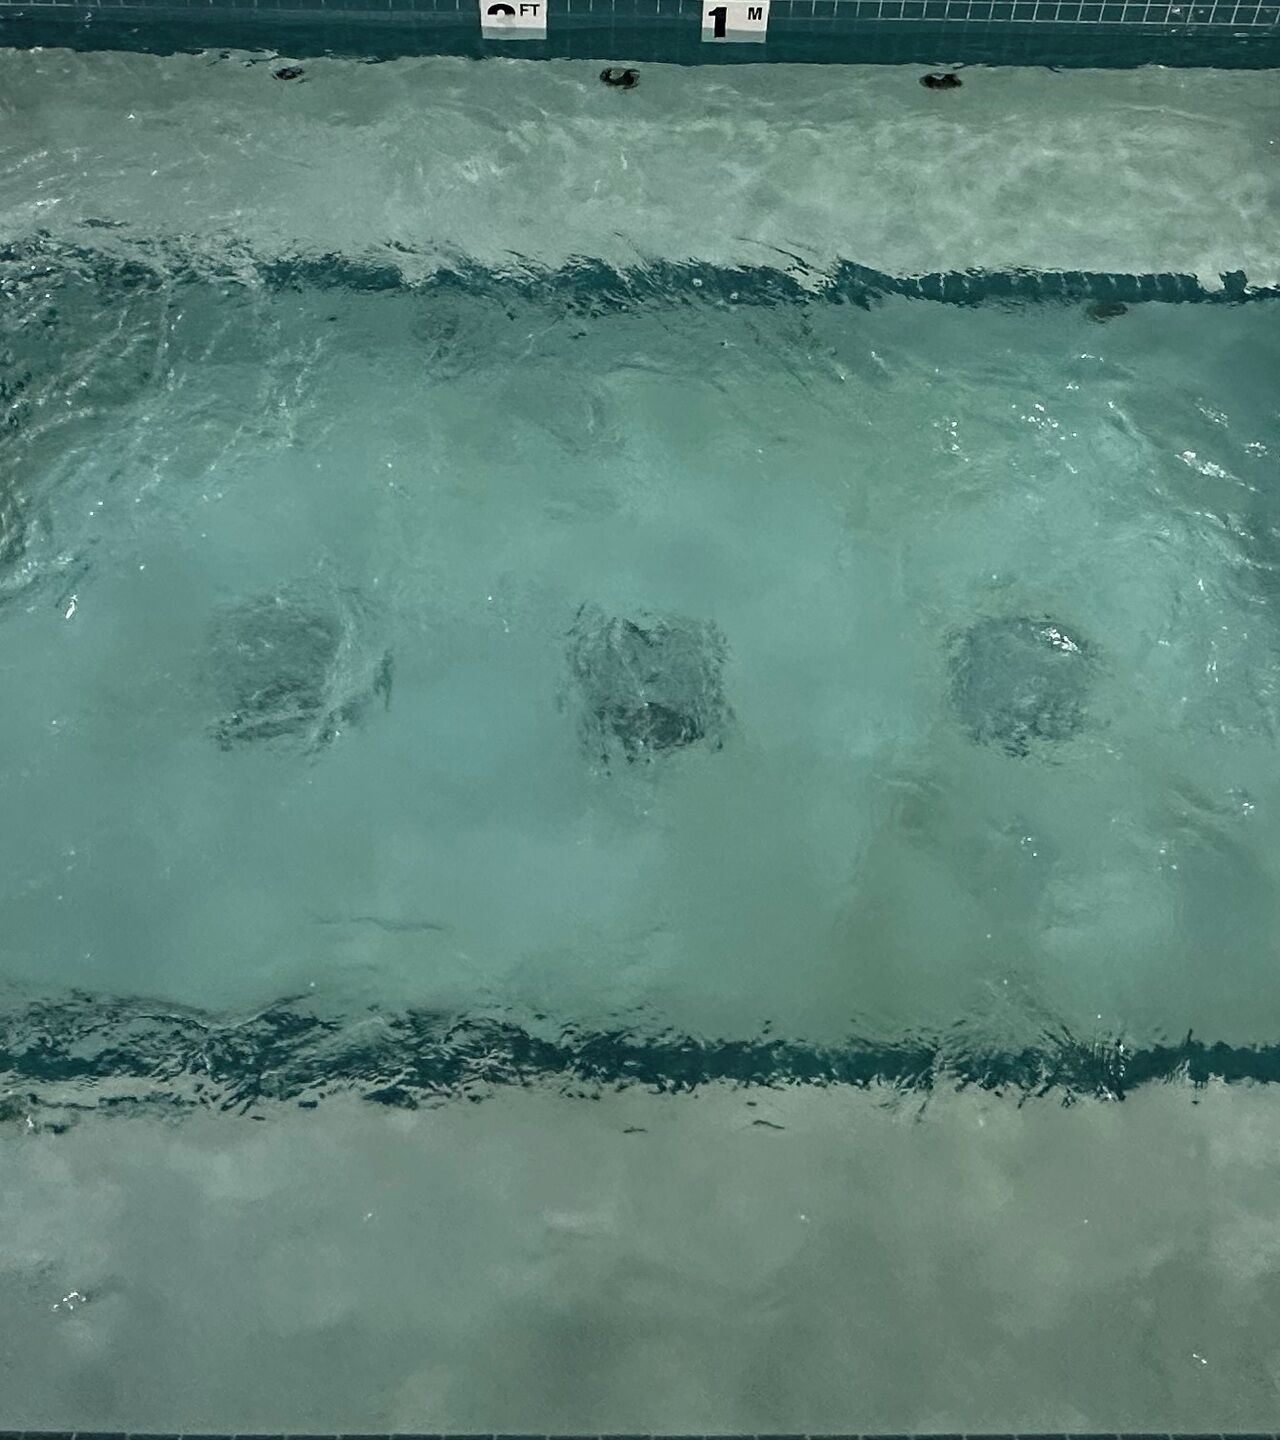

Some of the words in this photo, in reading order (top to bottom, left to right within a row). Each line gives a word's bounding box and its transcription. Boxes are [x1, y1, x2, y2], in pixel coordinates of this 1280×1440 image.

[519, 3, 540, 17] FT
[708, 6, 728, 38] 1
[747, 7, 763, 20] M
